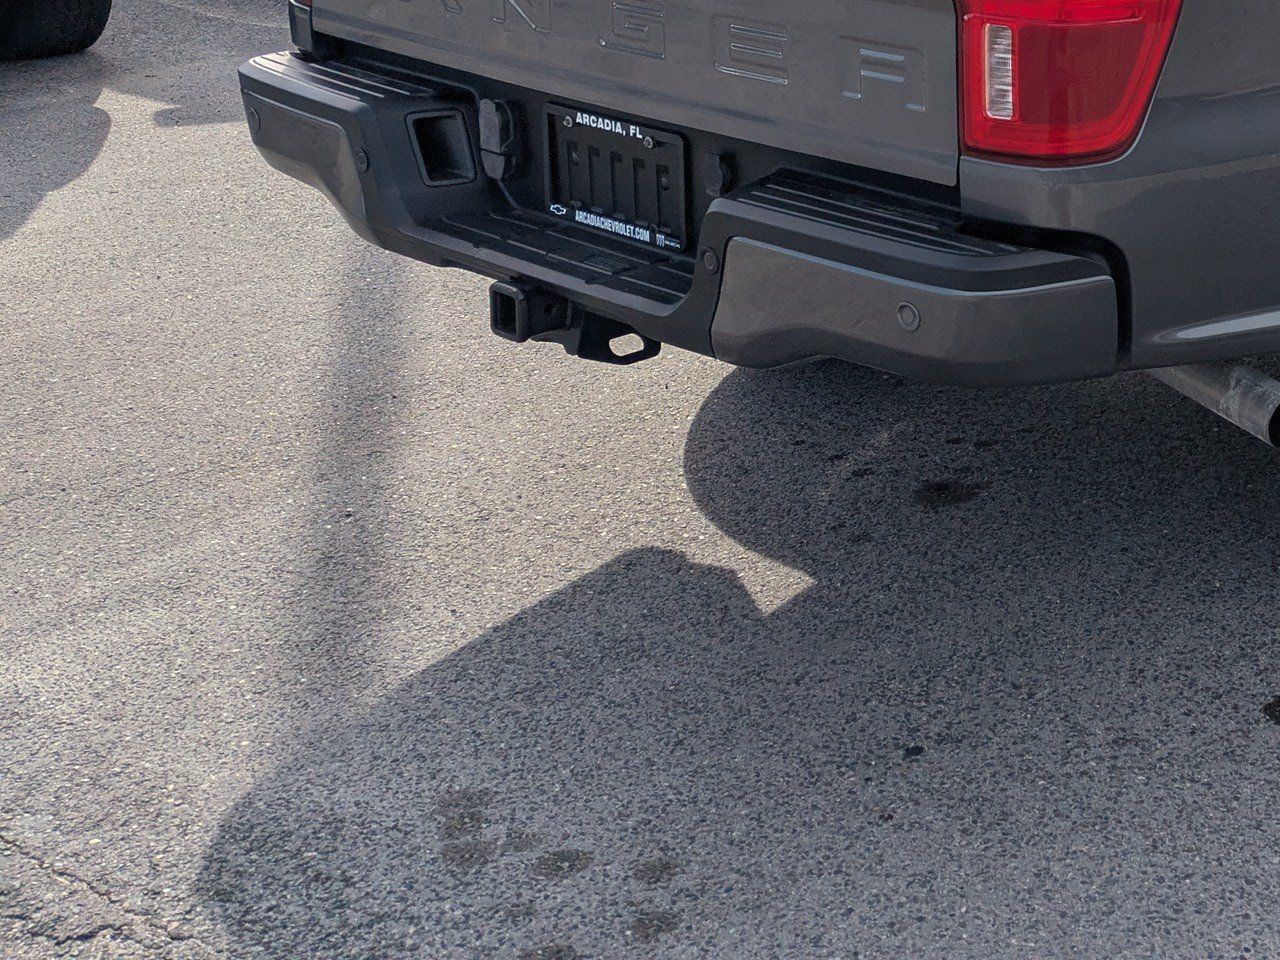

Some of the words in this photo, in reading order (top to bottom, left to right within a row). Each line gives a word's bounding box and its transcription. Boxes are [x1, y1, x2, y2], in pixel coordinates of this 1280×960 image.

[575, 112, 627, 136] ARCADIA,
[629, 125, 643, 139] FL
[575, 210, 650, 242] ARCADIACHEVROLET.COM
